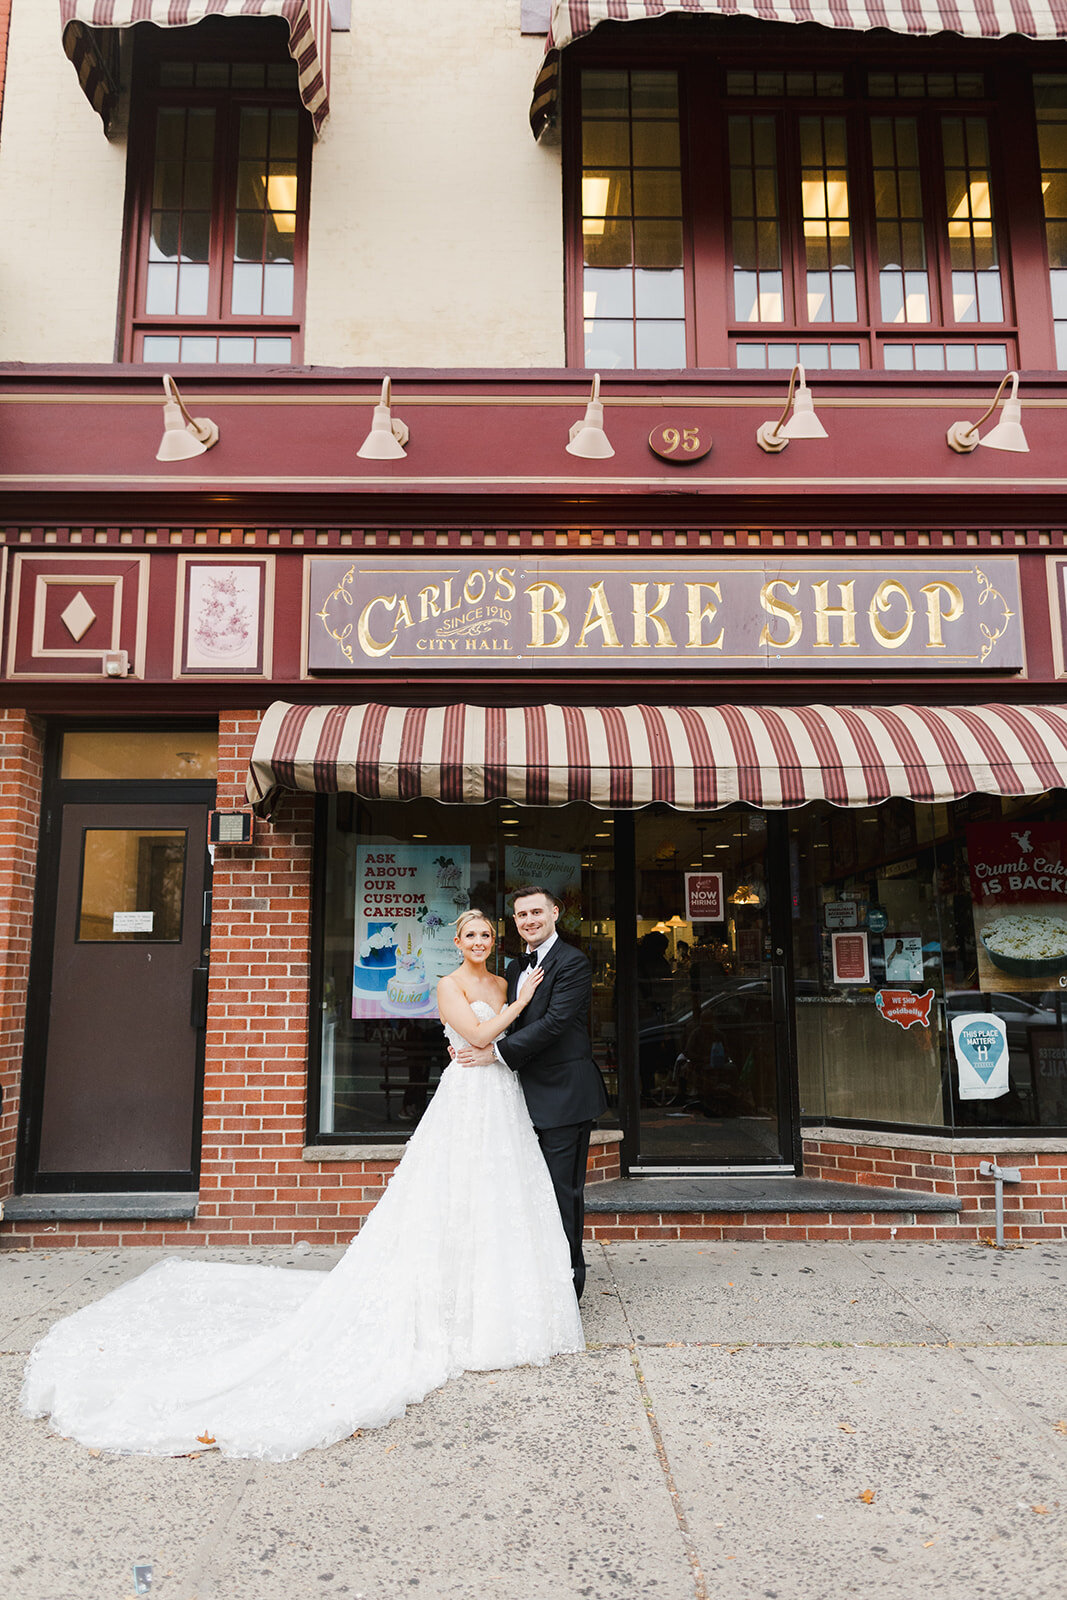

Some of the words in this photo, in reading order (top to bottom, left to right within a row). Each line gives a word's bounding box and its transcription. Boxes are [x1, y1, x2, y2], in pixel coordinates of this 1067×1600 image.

[662, 427, 700, 454] 95
[358, 566, 516, 658] CARLO'S
[523, 580, 725, 650] BAKE
[759, 578, 965, 650] SHOP
[443, 607, 483, 630] SINCE
[485, 605, 512, 621] 1910
[416, 638, 459, 650] CITY
[464, 638, 513, 650] HALL
[365, 854, 396, 864] ASK
[512, 850, 576, 881] Thanksgiving
[974, 857, 1031, 879] Crumb
[364, 867, 417, 877] ABOUT
[364, 880, 396, 890] OUR
[981, 879, 1002, 896] IS
[363, 893, 426, 904] CUSTOM
[691, 891, 717, 899] NOW
[363, 907, 416, 917] CAKES!
[389, 986, 423, 1003] Olivia
[978, 1030, 999, 1038] PLACE
[966, 1037, 996, 1045] MATTERS
